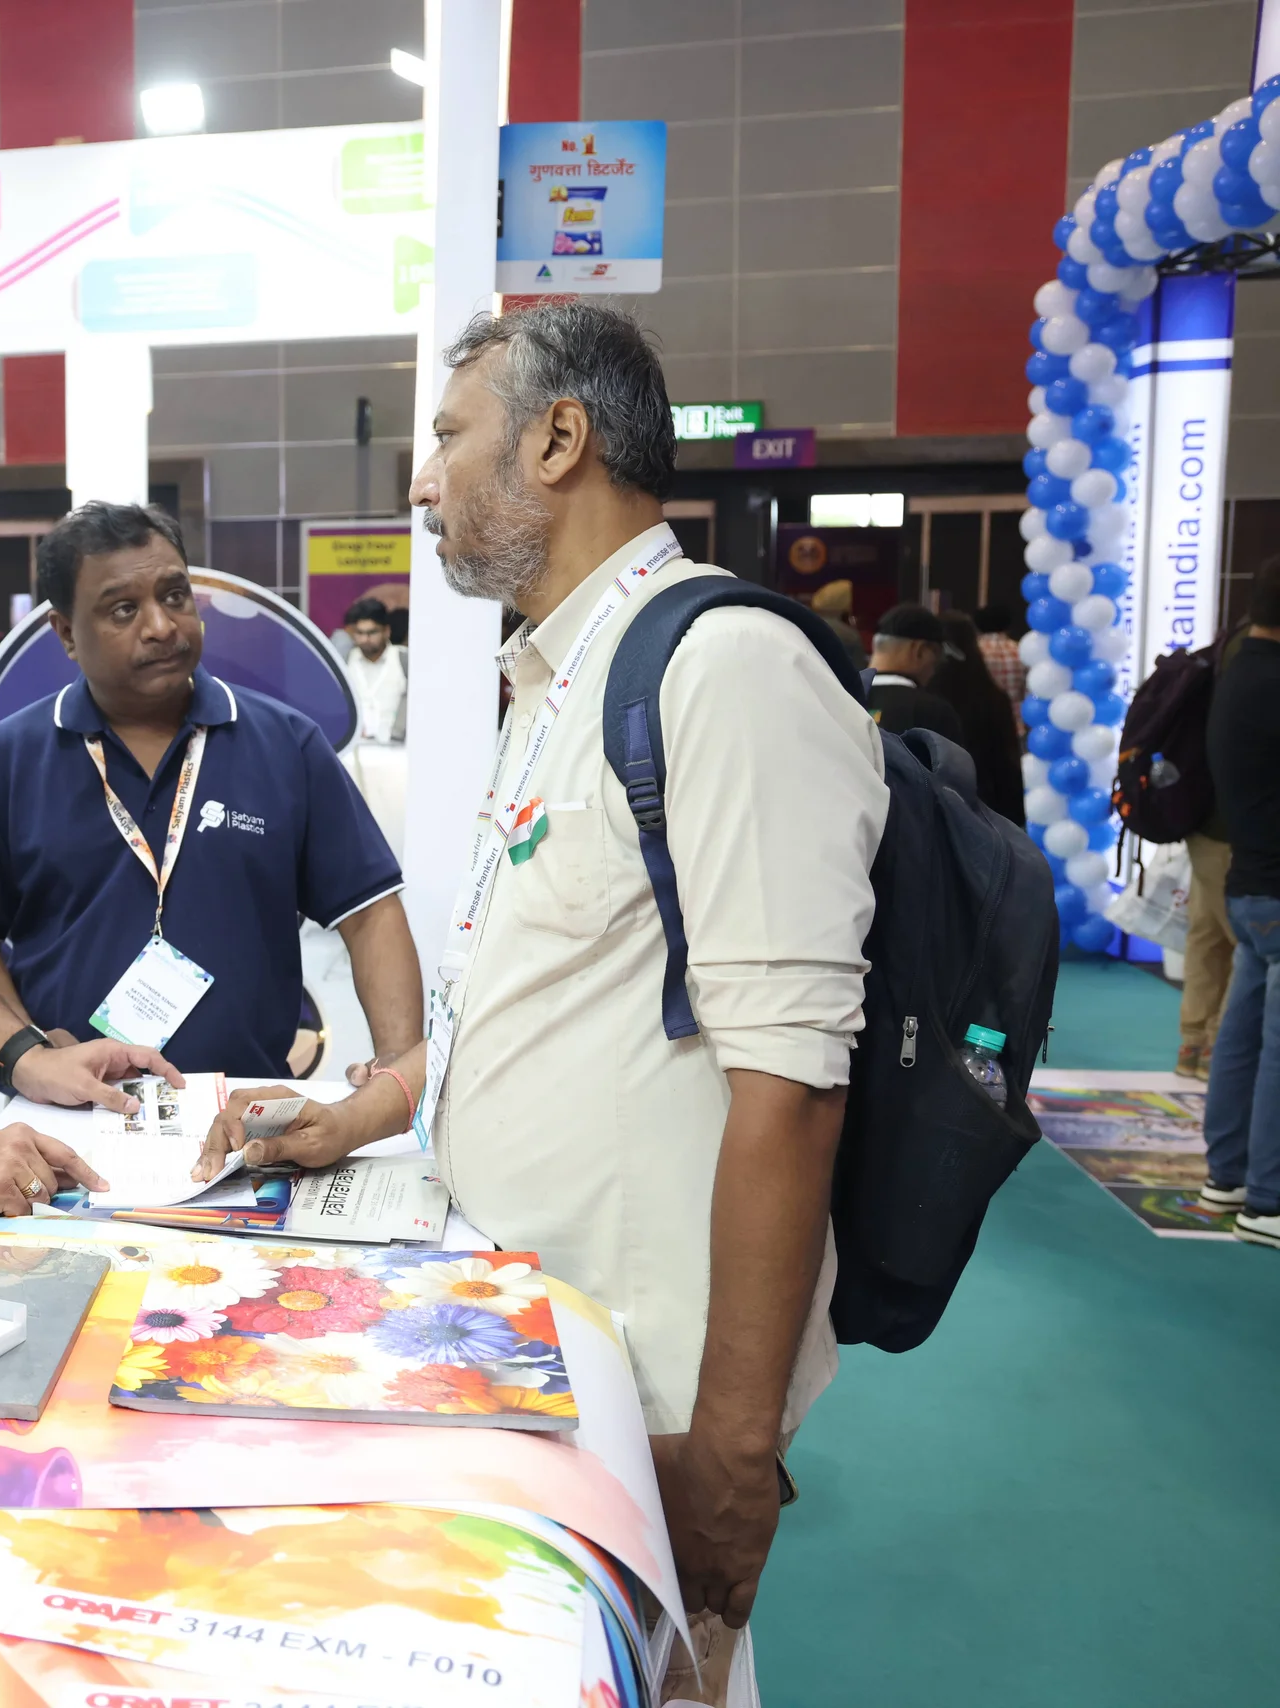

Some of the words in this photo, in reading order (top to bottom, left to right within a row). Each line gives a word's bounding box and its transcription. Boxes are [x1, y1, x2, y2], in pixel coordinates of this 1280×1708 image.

[581, 133, 597, 156] 1
[752, 437, 797, 460] EXIT
[646, 547, 670, 569] messe
[566, 644, 587, 677] messe
[583, 603, 616, 644] frankfurt
[180, 761, 195, 796] Plastics
[514, 769, 530, 801] messe
[527, 724, 549, 768] frankfurt
[172, 797, 189, 830] Satyam
[231, 810, 265, 826] Satyam
[231, 820, 265, 835] Plastics
[467, 890, 482, 921] messe
[476, 847, 499, 889] frankfurt
[178, 1616, 266, 1644] 3144
[279, 1631, 368, 1660] EXM
[407, 1650, 503, 1688] F010
